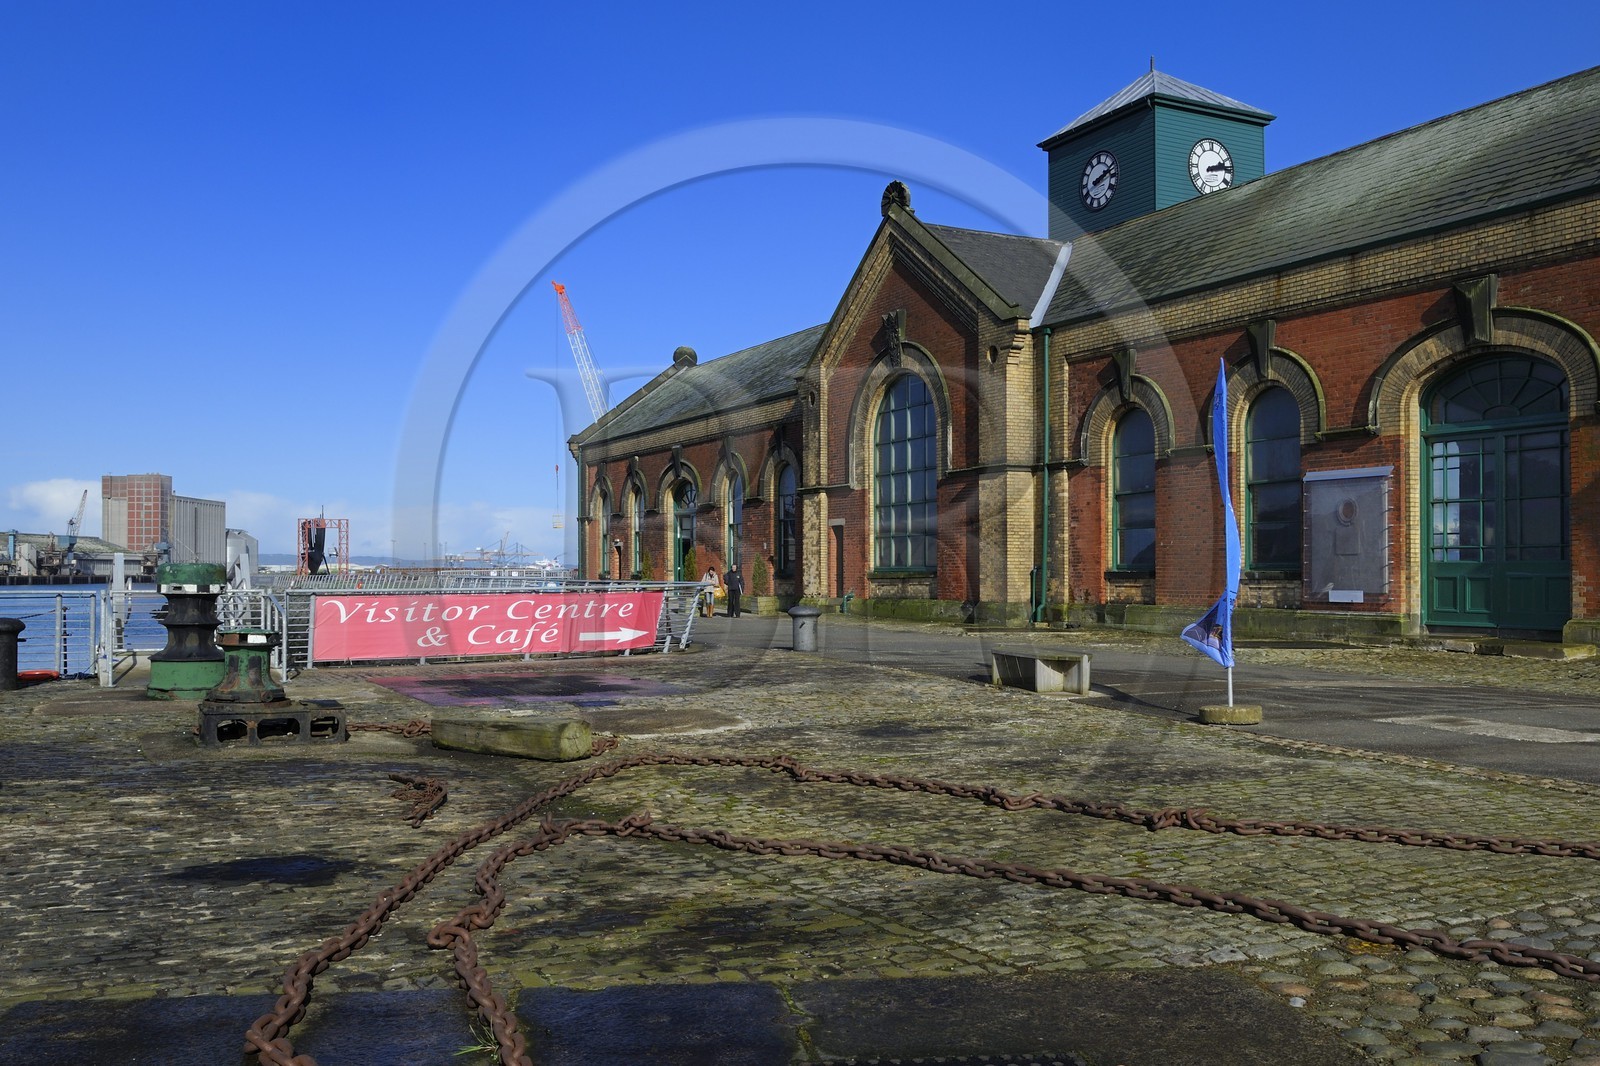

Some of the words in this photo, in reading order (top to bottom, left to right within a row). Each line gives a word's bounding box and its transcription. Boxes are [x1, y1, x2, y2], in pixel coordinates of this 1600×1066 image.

[322, 599, 490, 624] Visitor
[506, 599, 634, 620] Centre
[417, 626, 448, 647] &
[467, 621, 559, 651] Café
